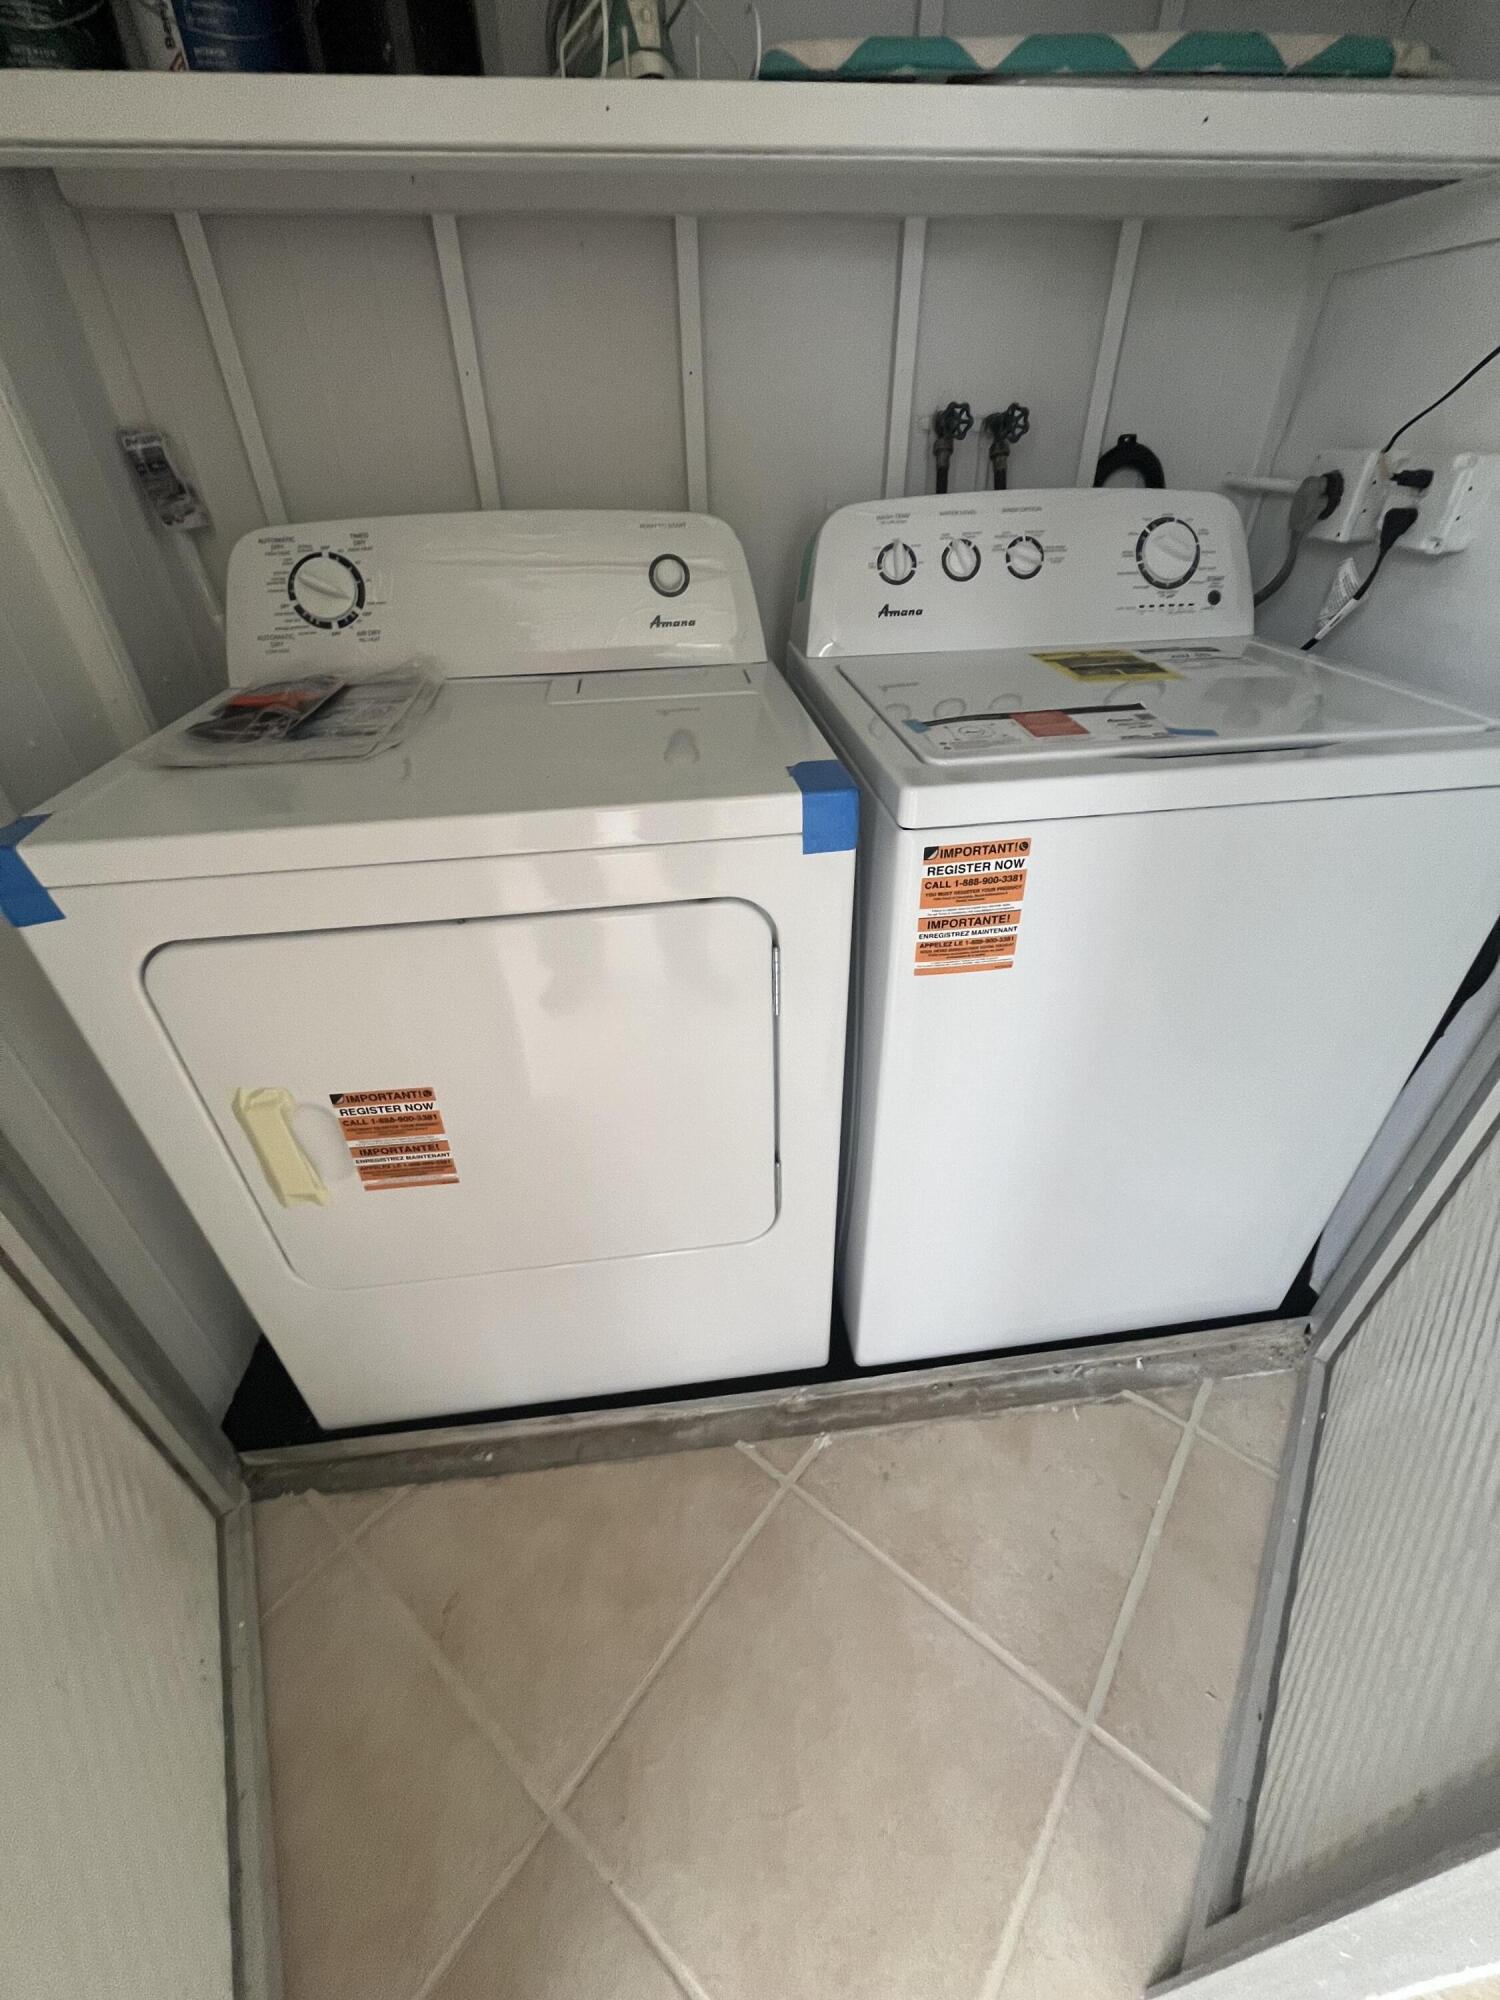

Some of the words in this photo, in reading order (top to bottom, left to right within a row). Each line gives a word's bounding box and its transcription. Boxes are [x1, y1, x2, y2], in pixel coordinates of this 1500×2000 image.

[878, 604, 923, 618] Amana
[650, 615, 696, 629] Amana
[940, 842, 1018, 859] IMPORTANT!
[927, 862, 991, 876] REGISTER
[994, 858, 1025, 870] NOW
[925, 879, 951, 889] CALL
[955, 874, 1023, 887] 1-888-900-3381
[927, 914, 1011, 929] IMPORTANTE!
[919, 930, 970, 940] ENREGISTREZ
[971, 926, 1018, 935] MAINTENANT
[920, 941, 952, 949] APPELEZ
[346, 1091, 421, 1103] IMPORTANT!
[340, 1105, 401, 1117] REGISTER
[405, 1102, 434, 1111] NOW
[342, 1119, 368, 1127] CALL
[359, 1144, 439, 1157] IMPORTANTE!
